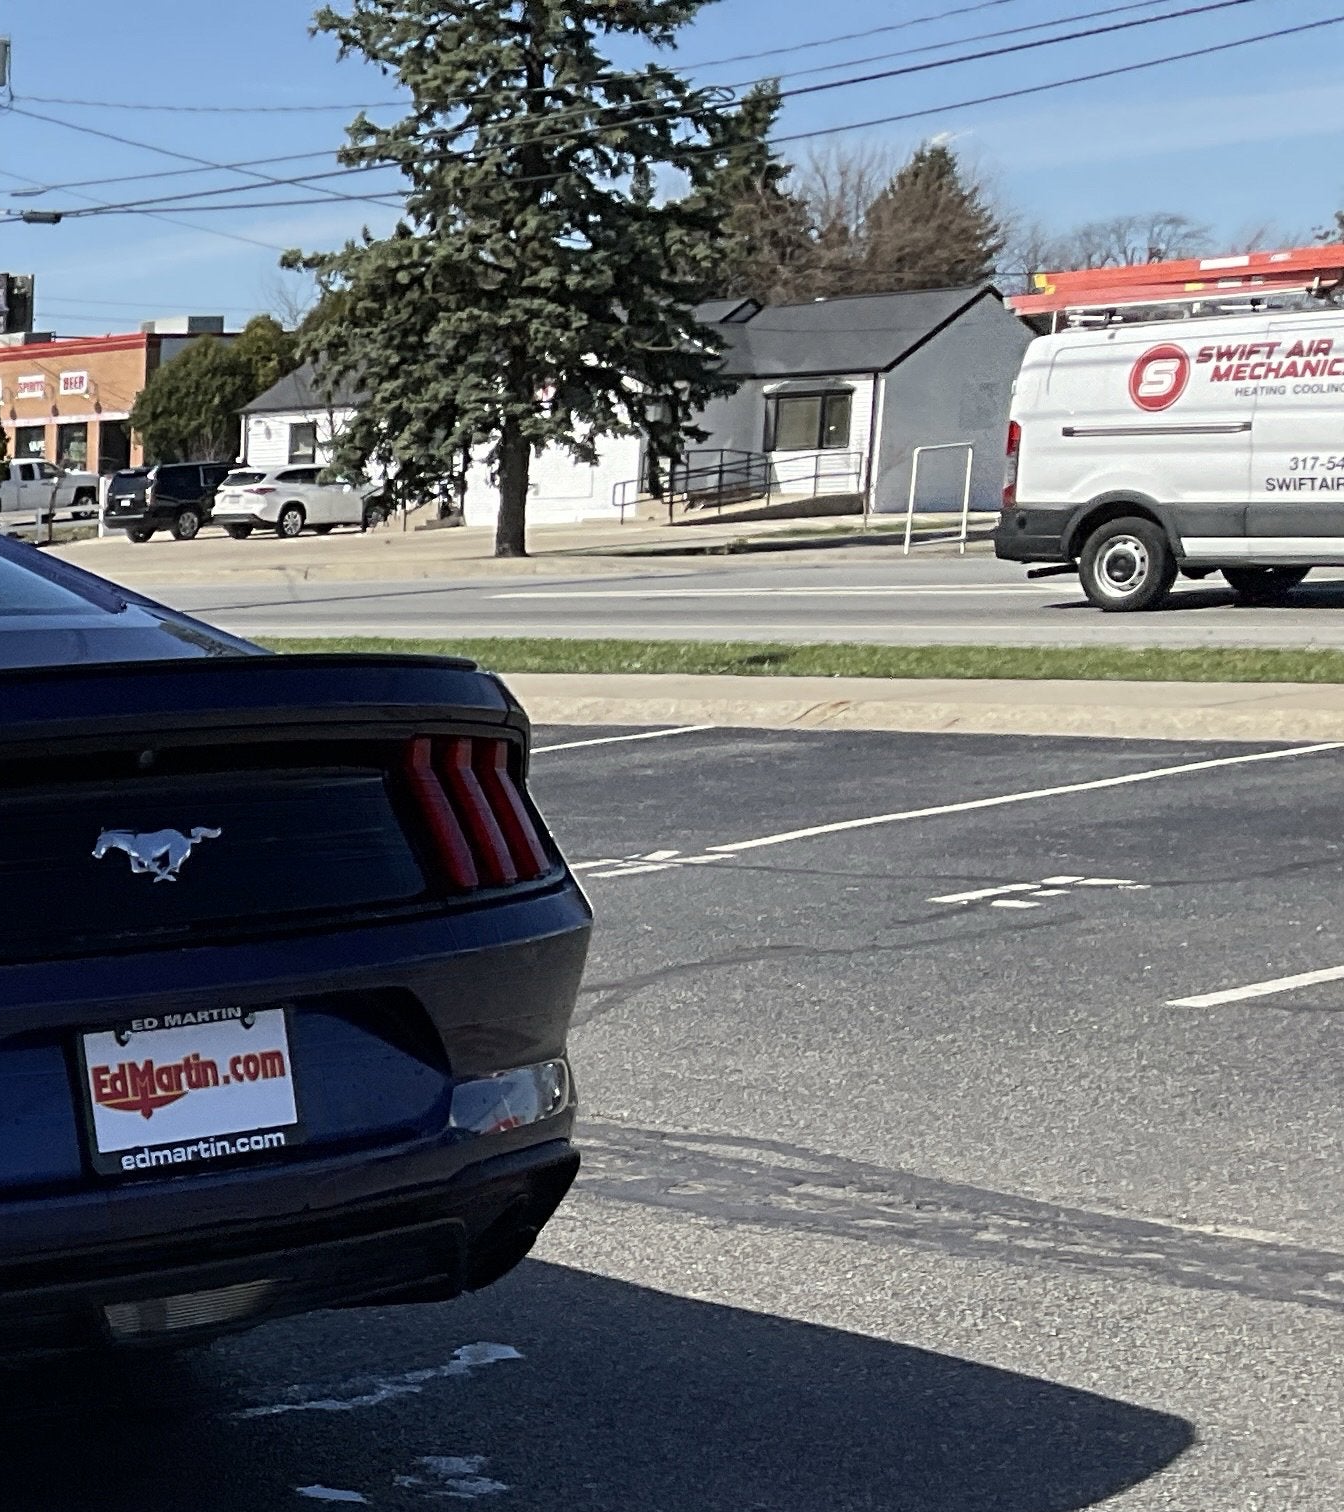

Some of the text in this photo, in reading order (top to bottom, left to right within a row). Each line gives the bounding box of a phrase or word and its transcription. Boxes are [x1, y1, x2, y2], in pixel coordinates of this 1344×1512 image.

[1196, 338, 1334, 364] SWIFT AIR
[63, 375, 85, 391] BEER
[1210, 358, 1344, 383] MECHANIC
[1235, 384, 1287, 397] HEATING
[131, 1006, 242, 1032] ED MARTIN
[92, 1050, 286, 1104] EdMartin.com
[121, 1131, 286, 1171] edmartin.com
